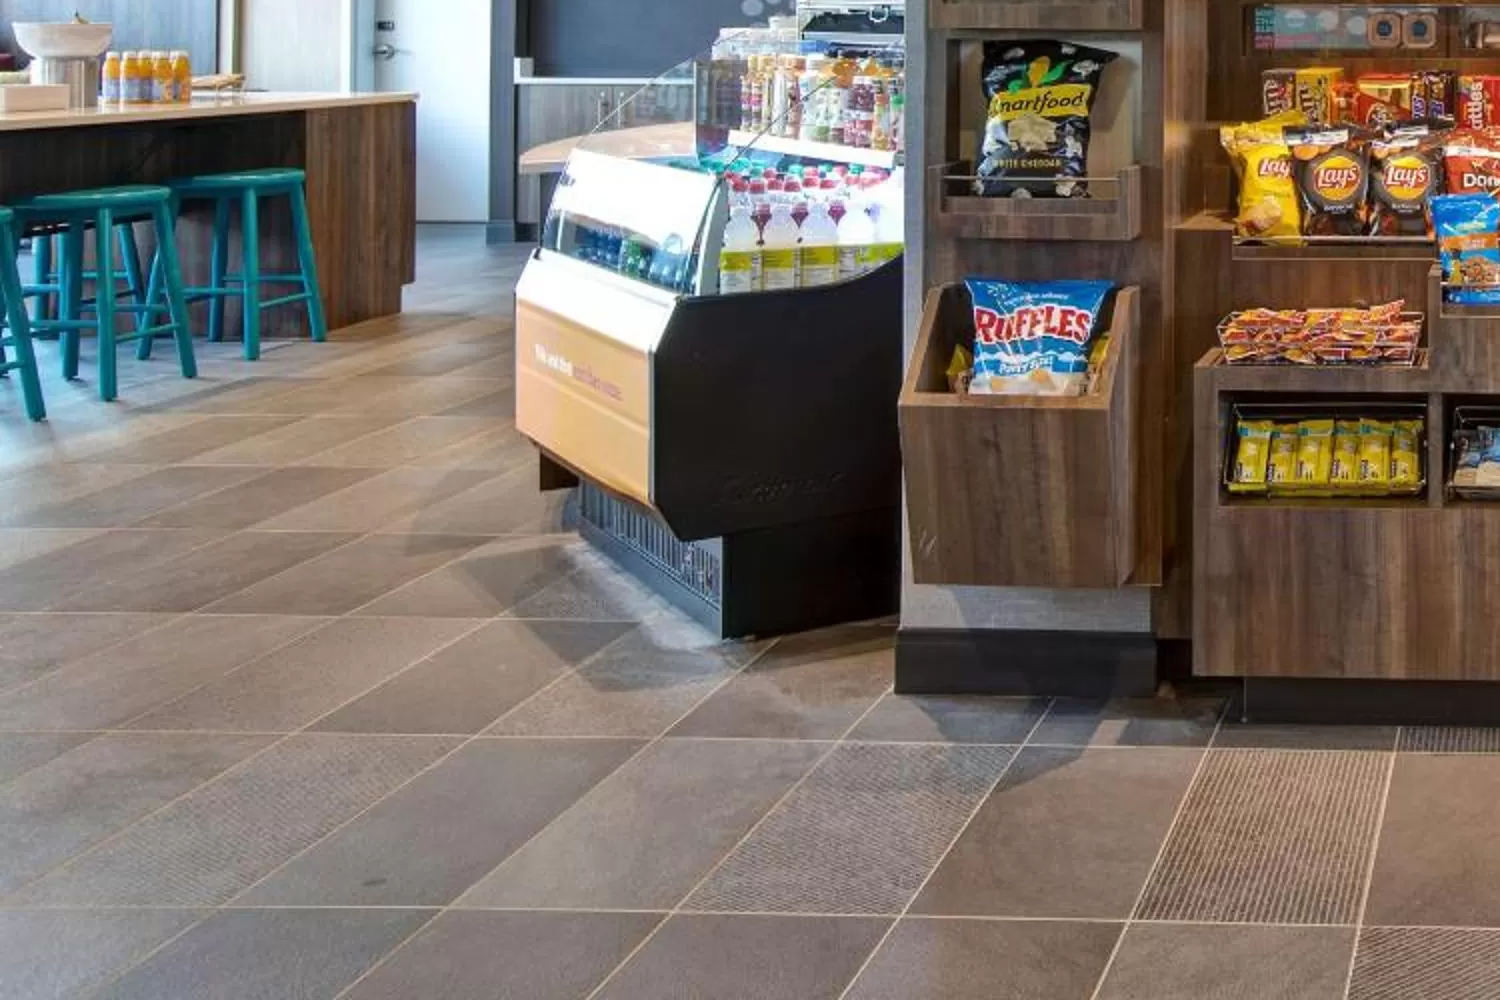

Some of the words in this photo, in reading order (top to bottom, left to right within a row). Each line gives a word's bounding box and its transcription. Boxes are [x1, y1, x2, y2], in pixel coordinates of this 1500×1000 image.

[1318, 167, 1357, 189] Lay's
[1386, 166, 1427, 189] Lay's
[975, 304, 1092, 344] RUFFLES
